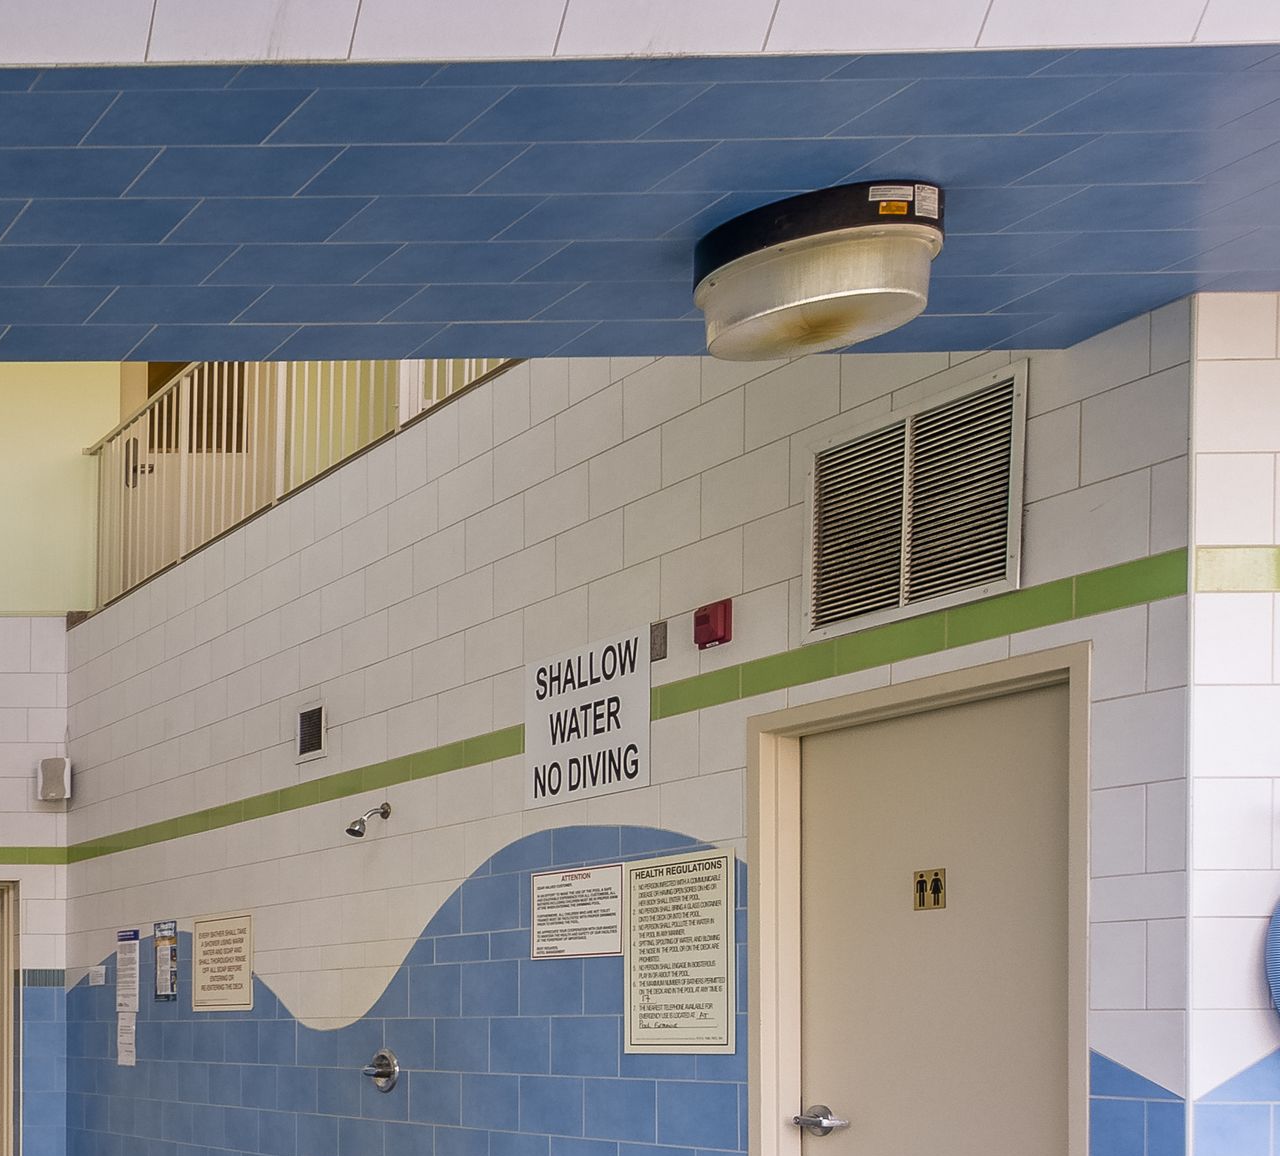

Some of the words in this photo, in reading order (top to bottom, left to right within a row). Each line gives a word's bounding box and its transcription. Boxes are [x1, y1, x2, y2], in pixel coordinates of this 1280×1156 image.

[536, 637, 638, 701] SHALLOW
[550, 696, 621, 745] WATER
[534, 762, 562, 799] NO
[569, 744, 639, 791] DIVING
[560, 871, 591, 882] ATTENTION
[635, 867, 664, 880] HEALTH
[665, 859, 722, 876] REGULATIONS
